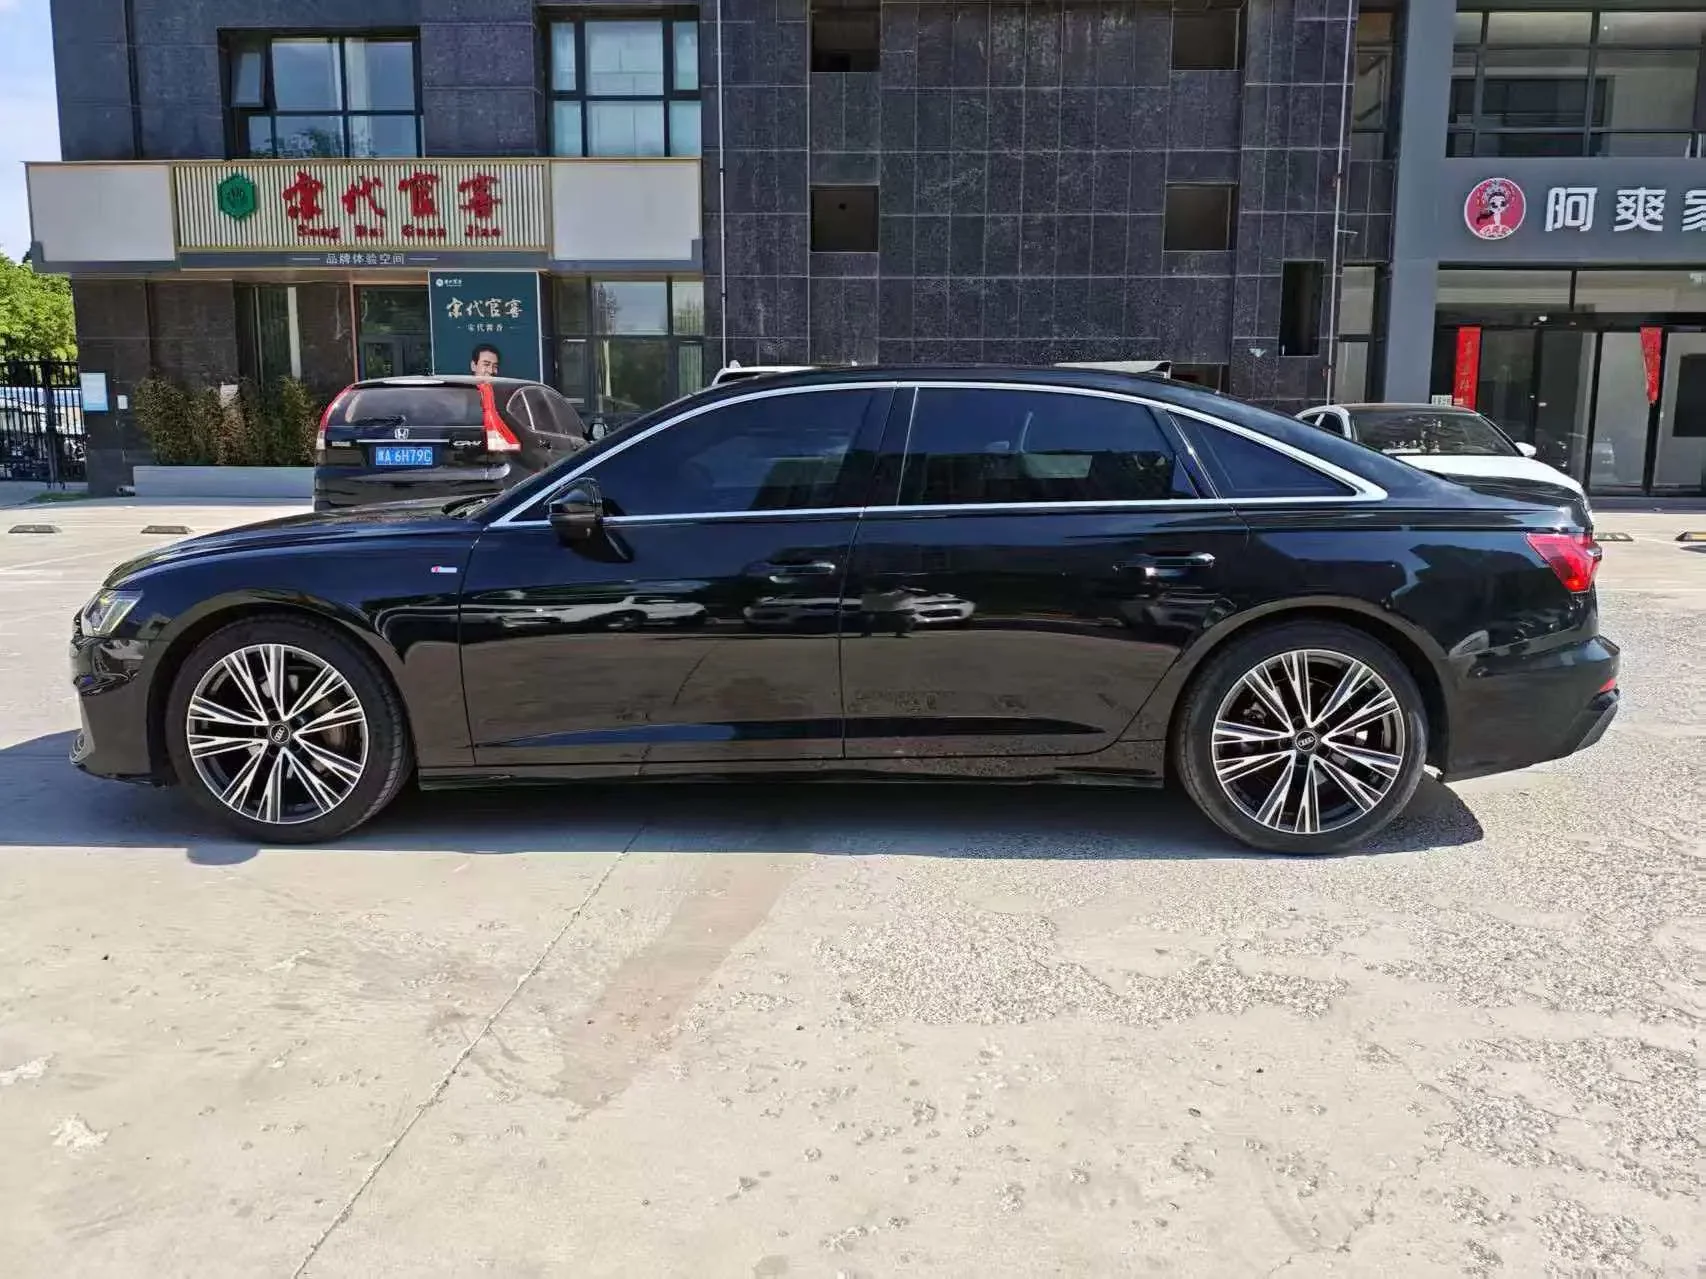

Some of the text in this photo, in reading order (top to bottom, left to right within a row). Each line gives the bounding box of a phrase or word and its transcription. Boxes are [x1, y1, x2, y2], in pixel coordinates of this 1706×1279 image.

[326, 252, 405, 265] 品牌体验空间
